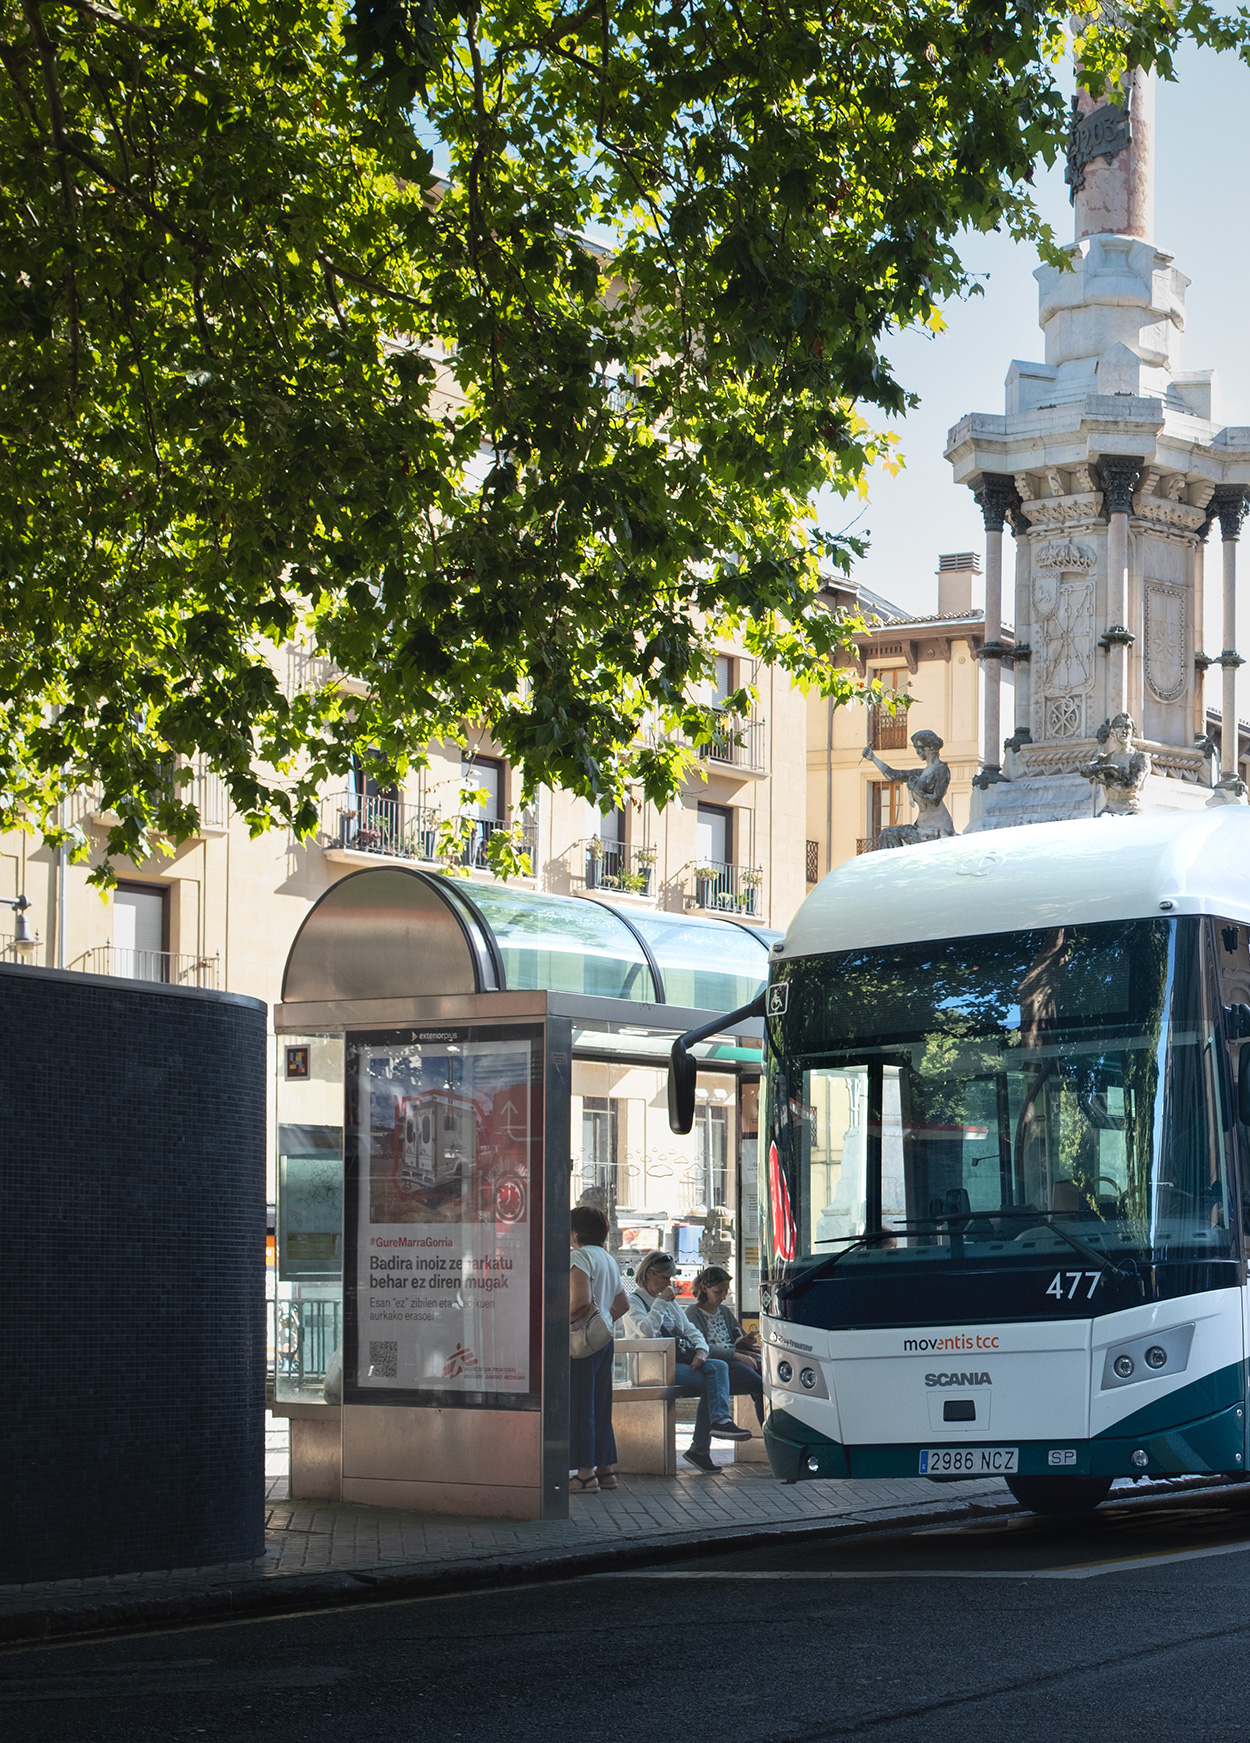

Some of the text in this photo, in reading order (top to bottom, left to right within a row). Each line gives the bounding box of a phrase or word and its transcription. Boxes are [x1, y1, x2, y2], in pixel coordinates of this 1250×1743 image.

[370, 1236, 453, 1248] #GureMarraGorria
[369, 1255, 513, 1270] Badira inoiz zearkatu
[369, 1273, 509, 1292] behar ez diren mugak
[1045, 1271, 1102, 1299] 477
[369, 1297, 391, 1308] Esan
[439, 1299, 452, 1308] eta
[369, 1310, 403, 1321] aurkako
[903, 1333, 999, 1351] moventis tcc
[924, 1371, 993, 1387] SCANIA
[930, 1450, 1015, 1471] 2986 NCZ
[1051, 1451, 1075, 1464] SP
